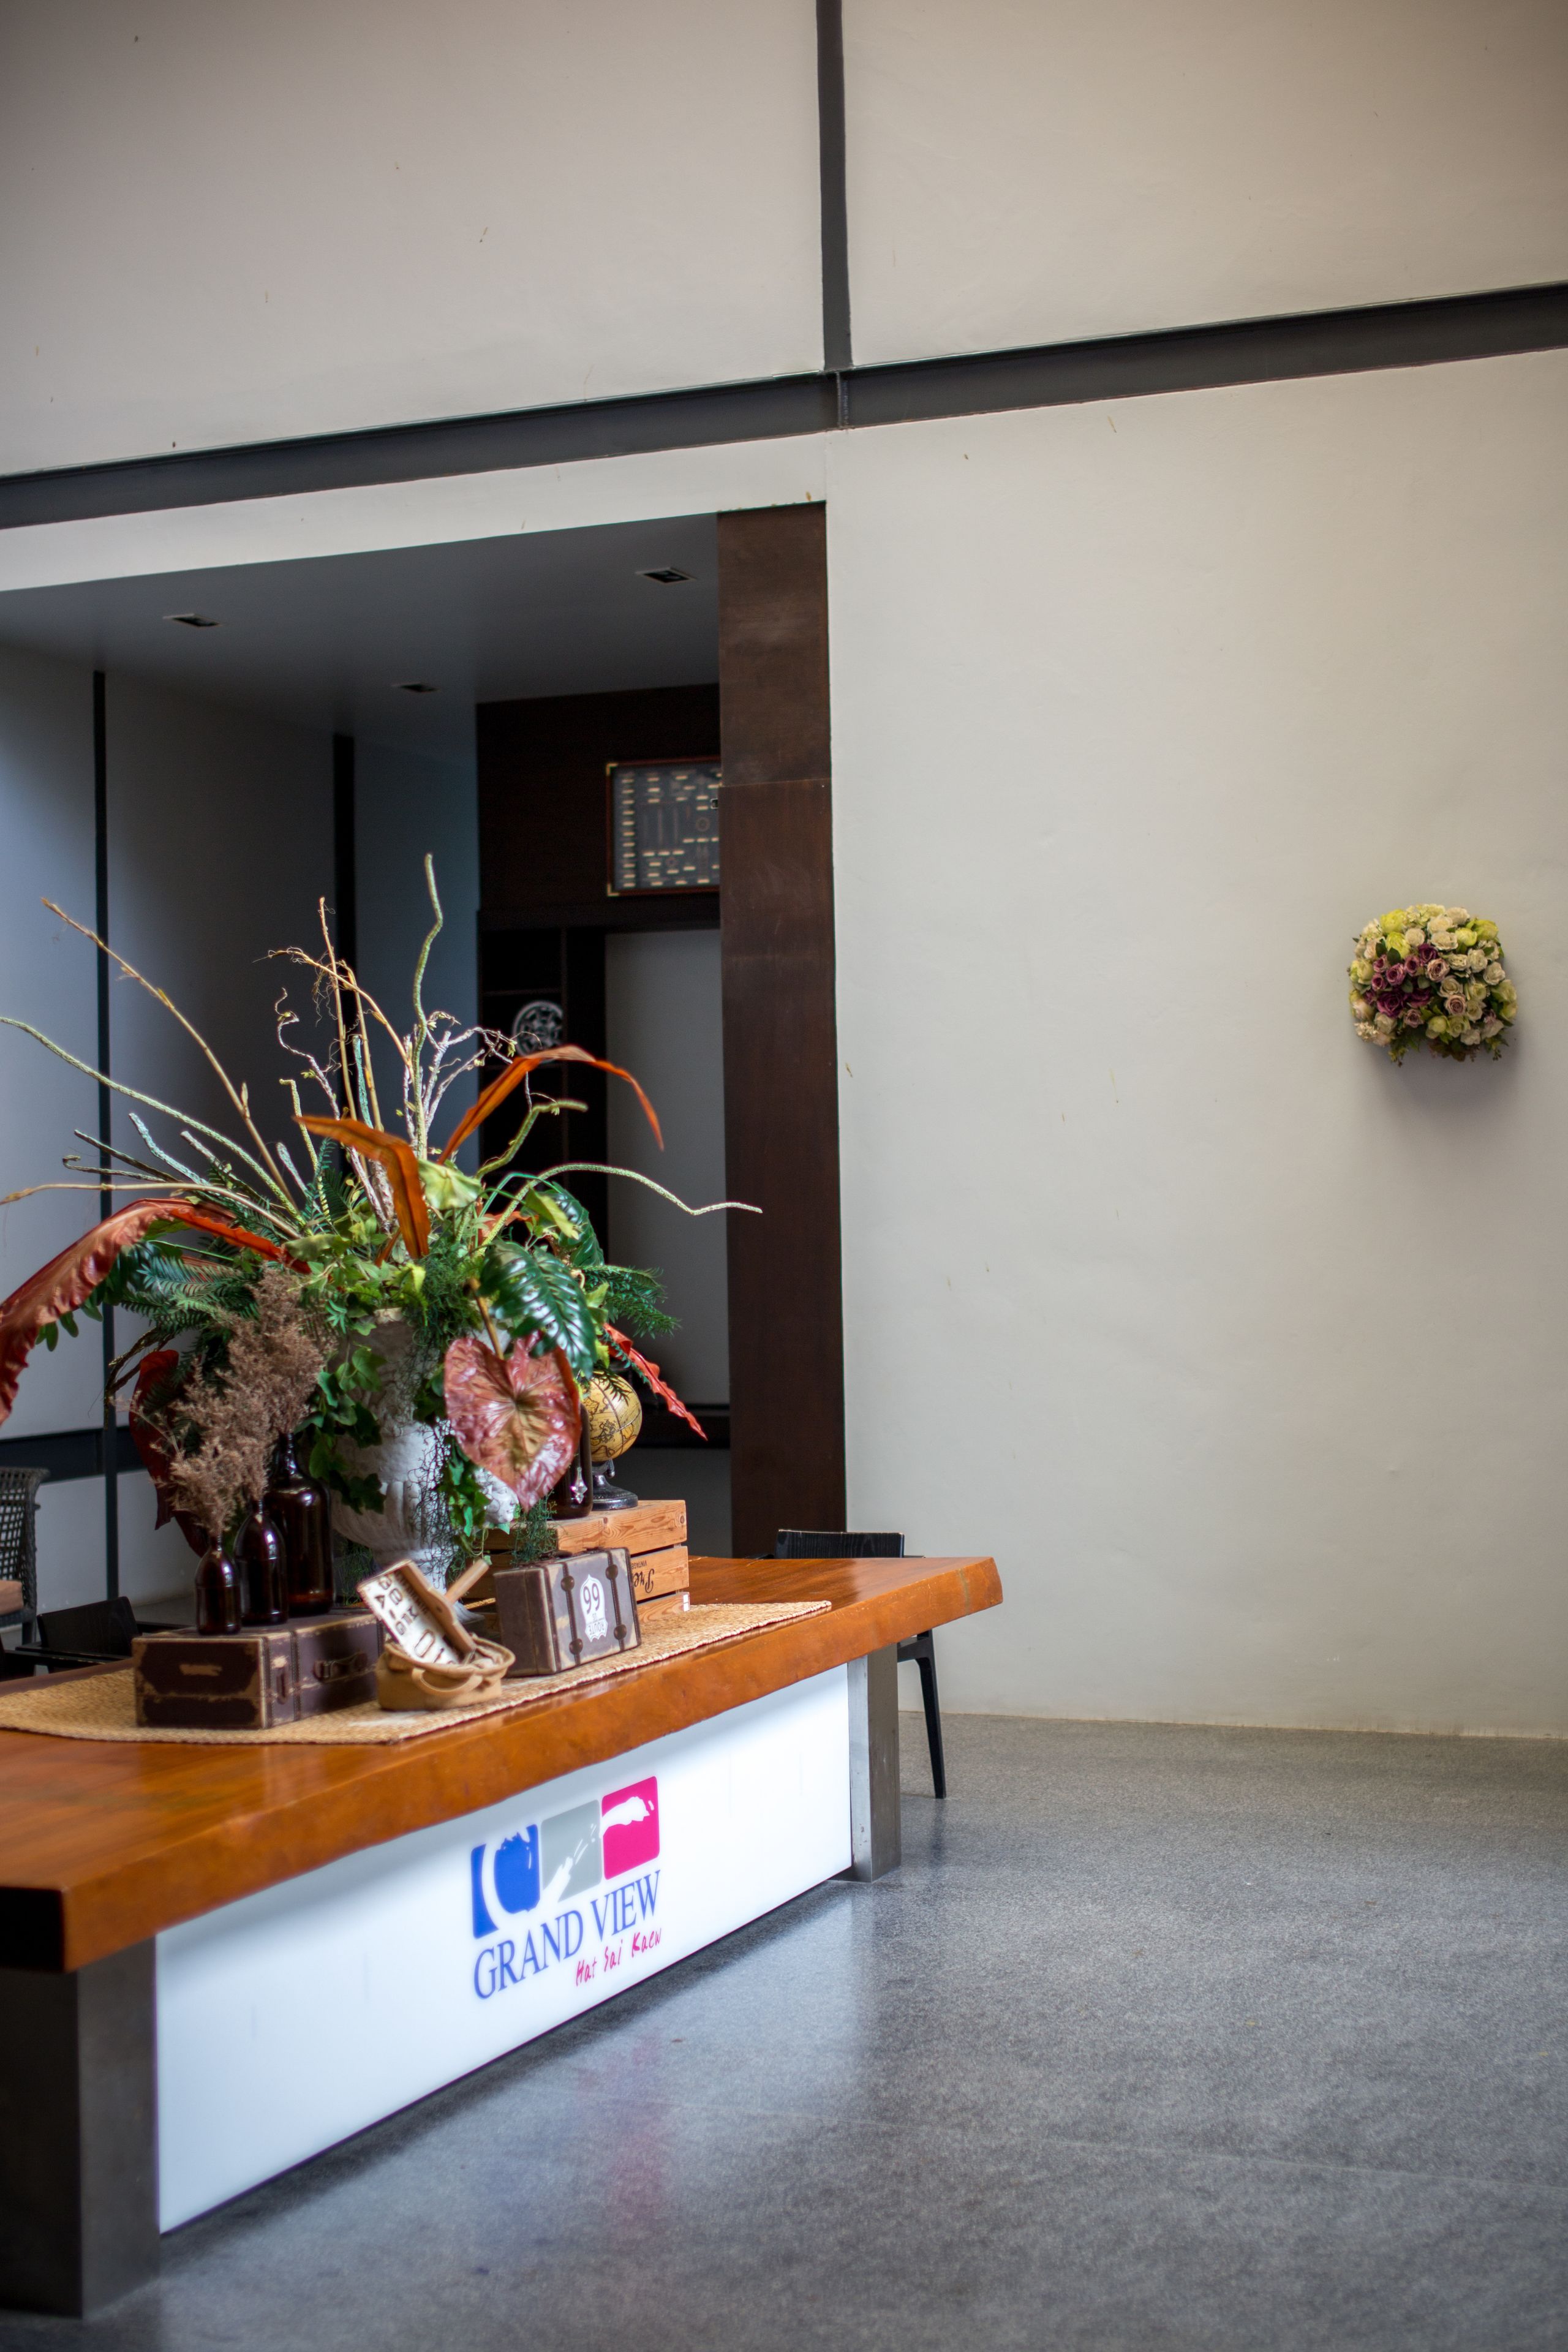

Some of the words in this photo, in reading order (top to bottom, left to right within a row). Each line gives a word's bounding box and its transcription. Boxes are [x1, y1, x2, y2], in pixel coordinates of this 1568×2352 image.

[588, 1622, 605, 1635] ROUTE
[473, 1909, 584, 2000] GRAND
[590, 1869, 662, 1943] VIEW
[575, 1958, 597, 1986] Hat
[603, 1939, 624, 1972] Sai
[631, 1928, 662, 1958] Kaew
